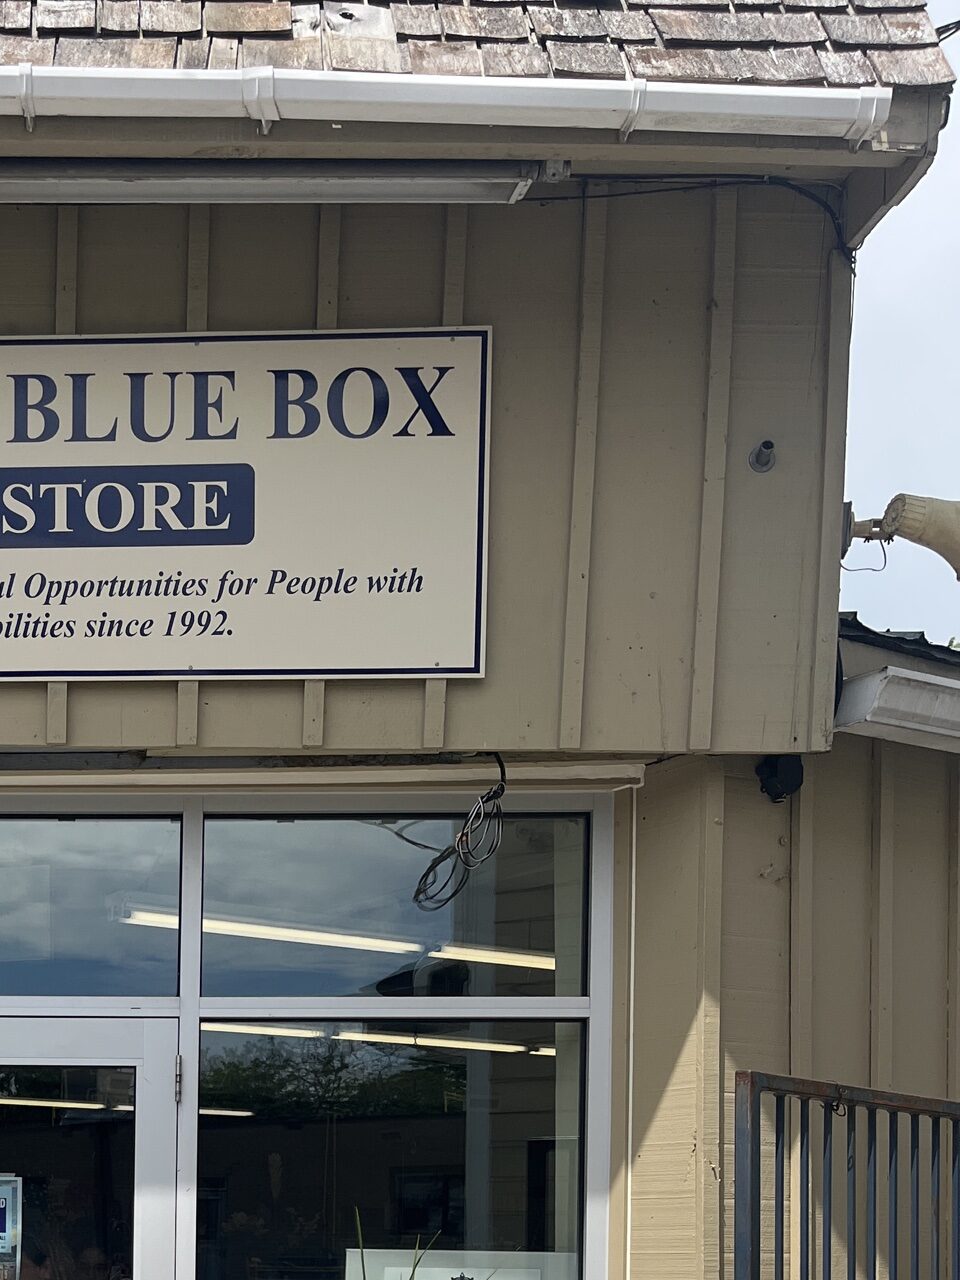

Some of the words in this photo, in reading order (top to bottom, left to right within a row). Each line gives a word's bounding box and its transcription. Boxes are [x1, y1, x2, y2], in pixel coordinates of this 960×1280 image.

[5, 370, 240, 444] BLUE
[266, 366, 456, 440] BOX
[2, 480, 231, 534] STORE
[24, 570, 208, 605] Opportunities
[213, 569, 258, 602] for
[265, 568, 358, 602] People
[367, 567, 424, 594] with
[83, 611, 154, 638] since
[162, 610, 233, 637] 1992.
